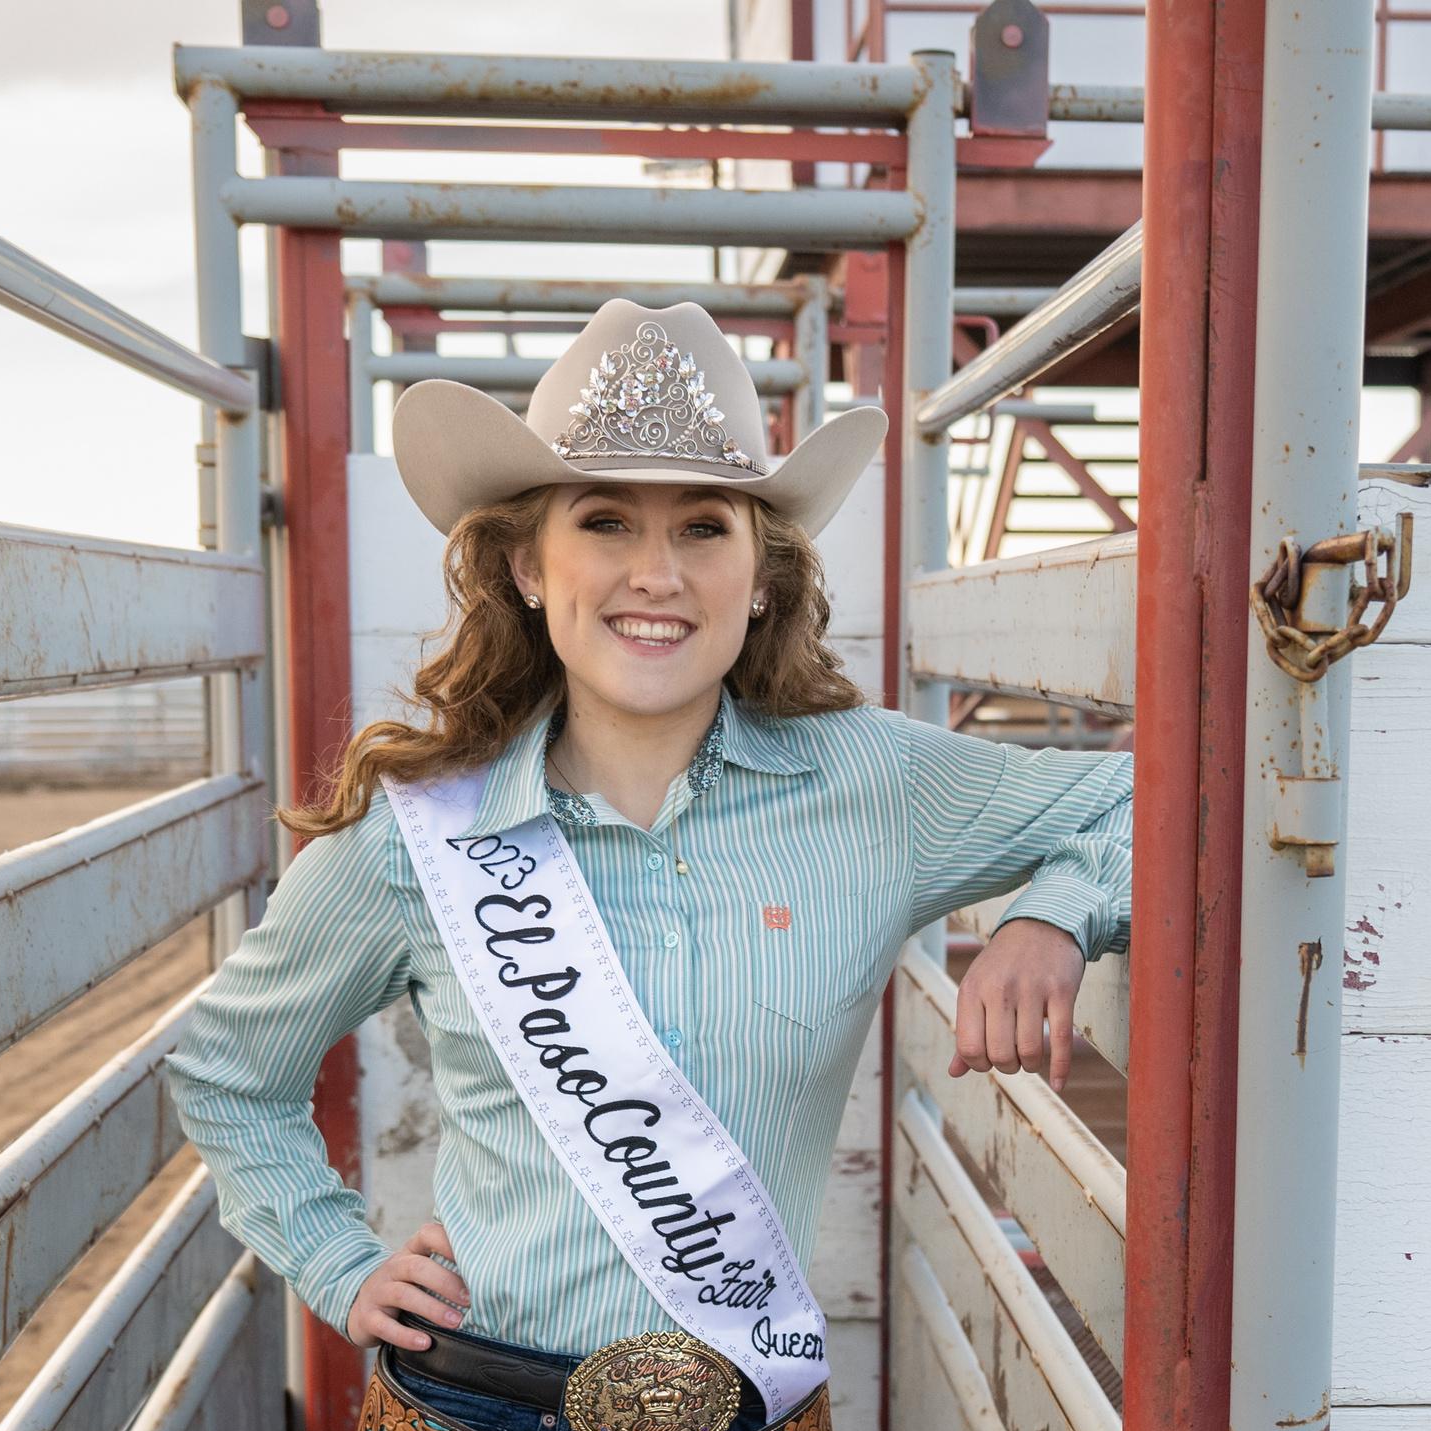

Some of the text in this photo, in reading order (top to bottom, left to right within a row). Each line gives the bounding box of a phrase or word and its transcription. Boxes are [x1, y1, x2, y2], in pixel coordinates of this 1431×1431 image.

[474, 894, 556, 960] El
[498, 961, 608, 1107] Paso
[584, 1099, 736, 1281] County
[698, 1259, 777, 1310] Fair
